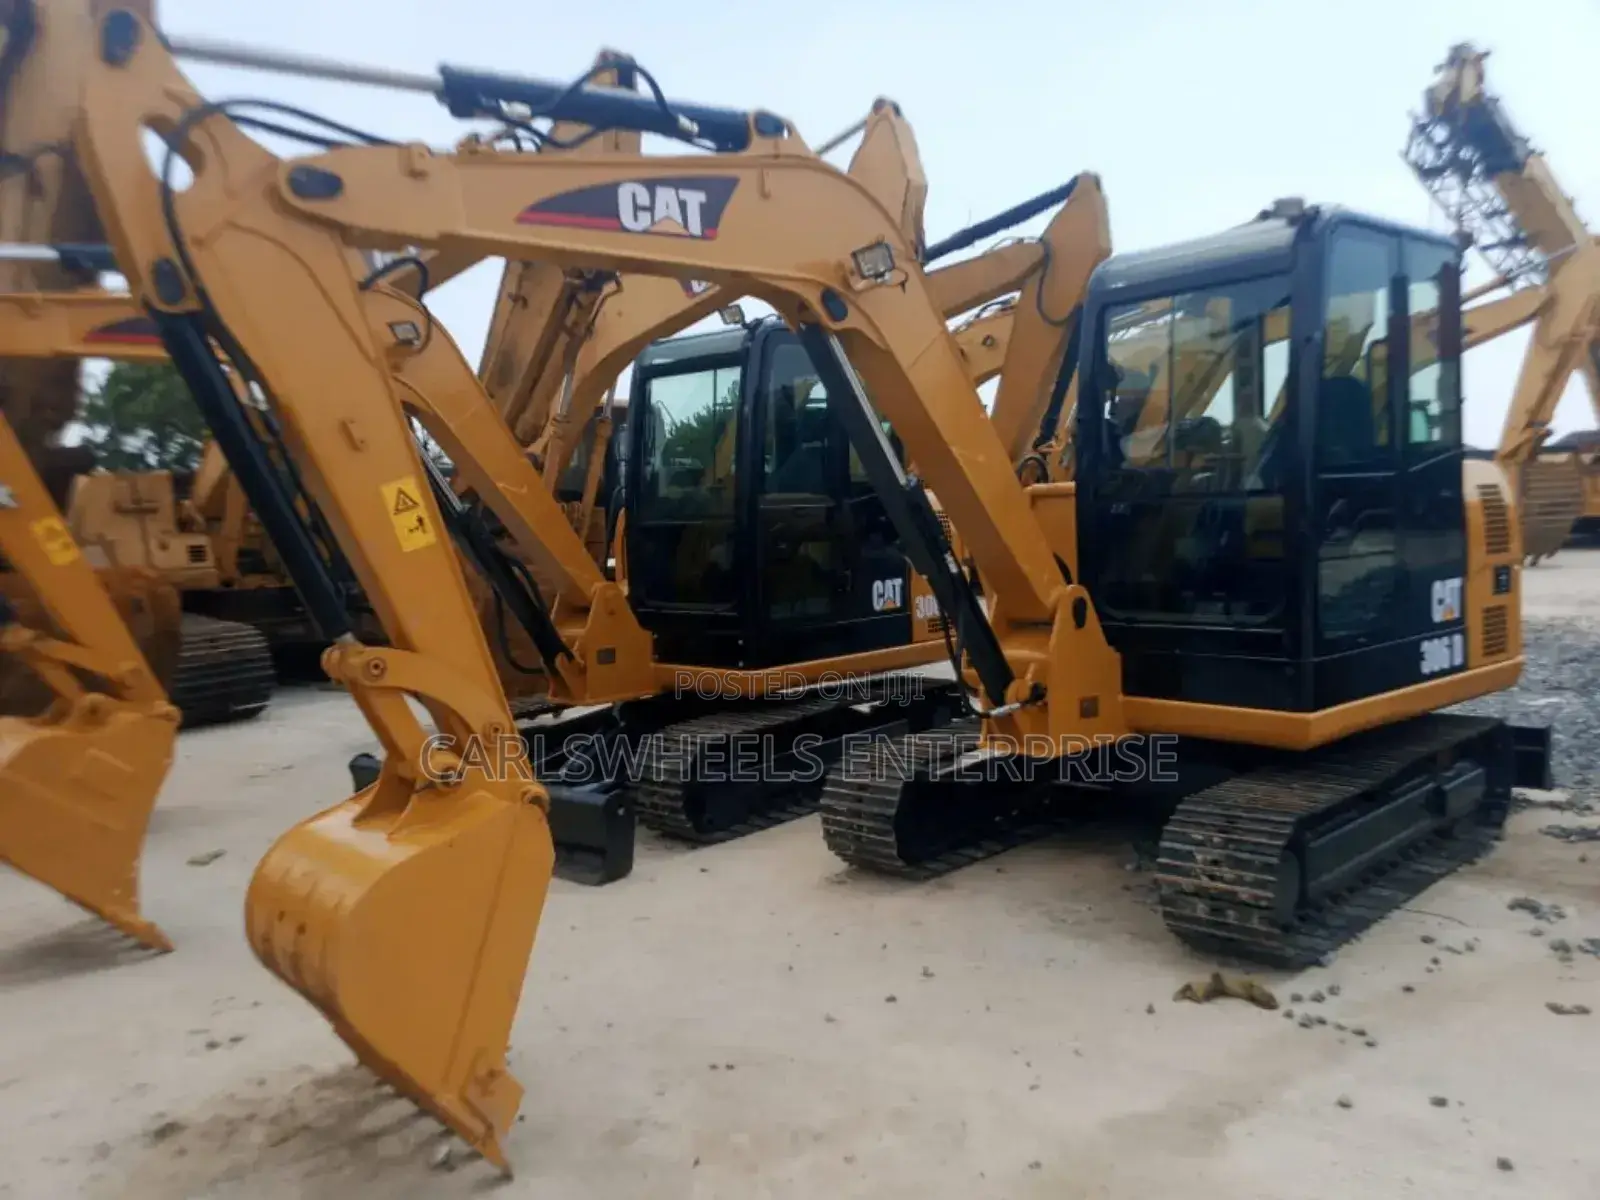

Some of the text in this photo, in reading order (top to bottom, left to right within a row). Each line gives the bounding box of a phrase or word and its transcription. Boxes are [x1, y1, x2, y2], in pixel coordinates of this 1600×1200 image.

[617, 181, 707, 237] CAT
[872, 578, 903, 612] CAT
[1430, 577, 1463, 622] CAT
